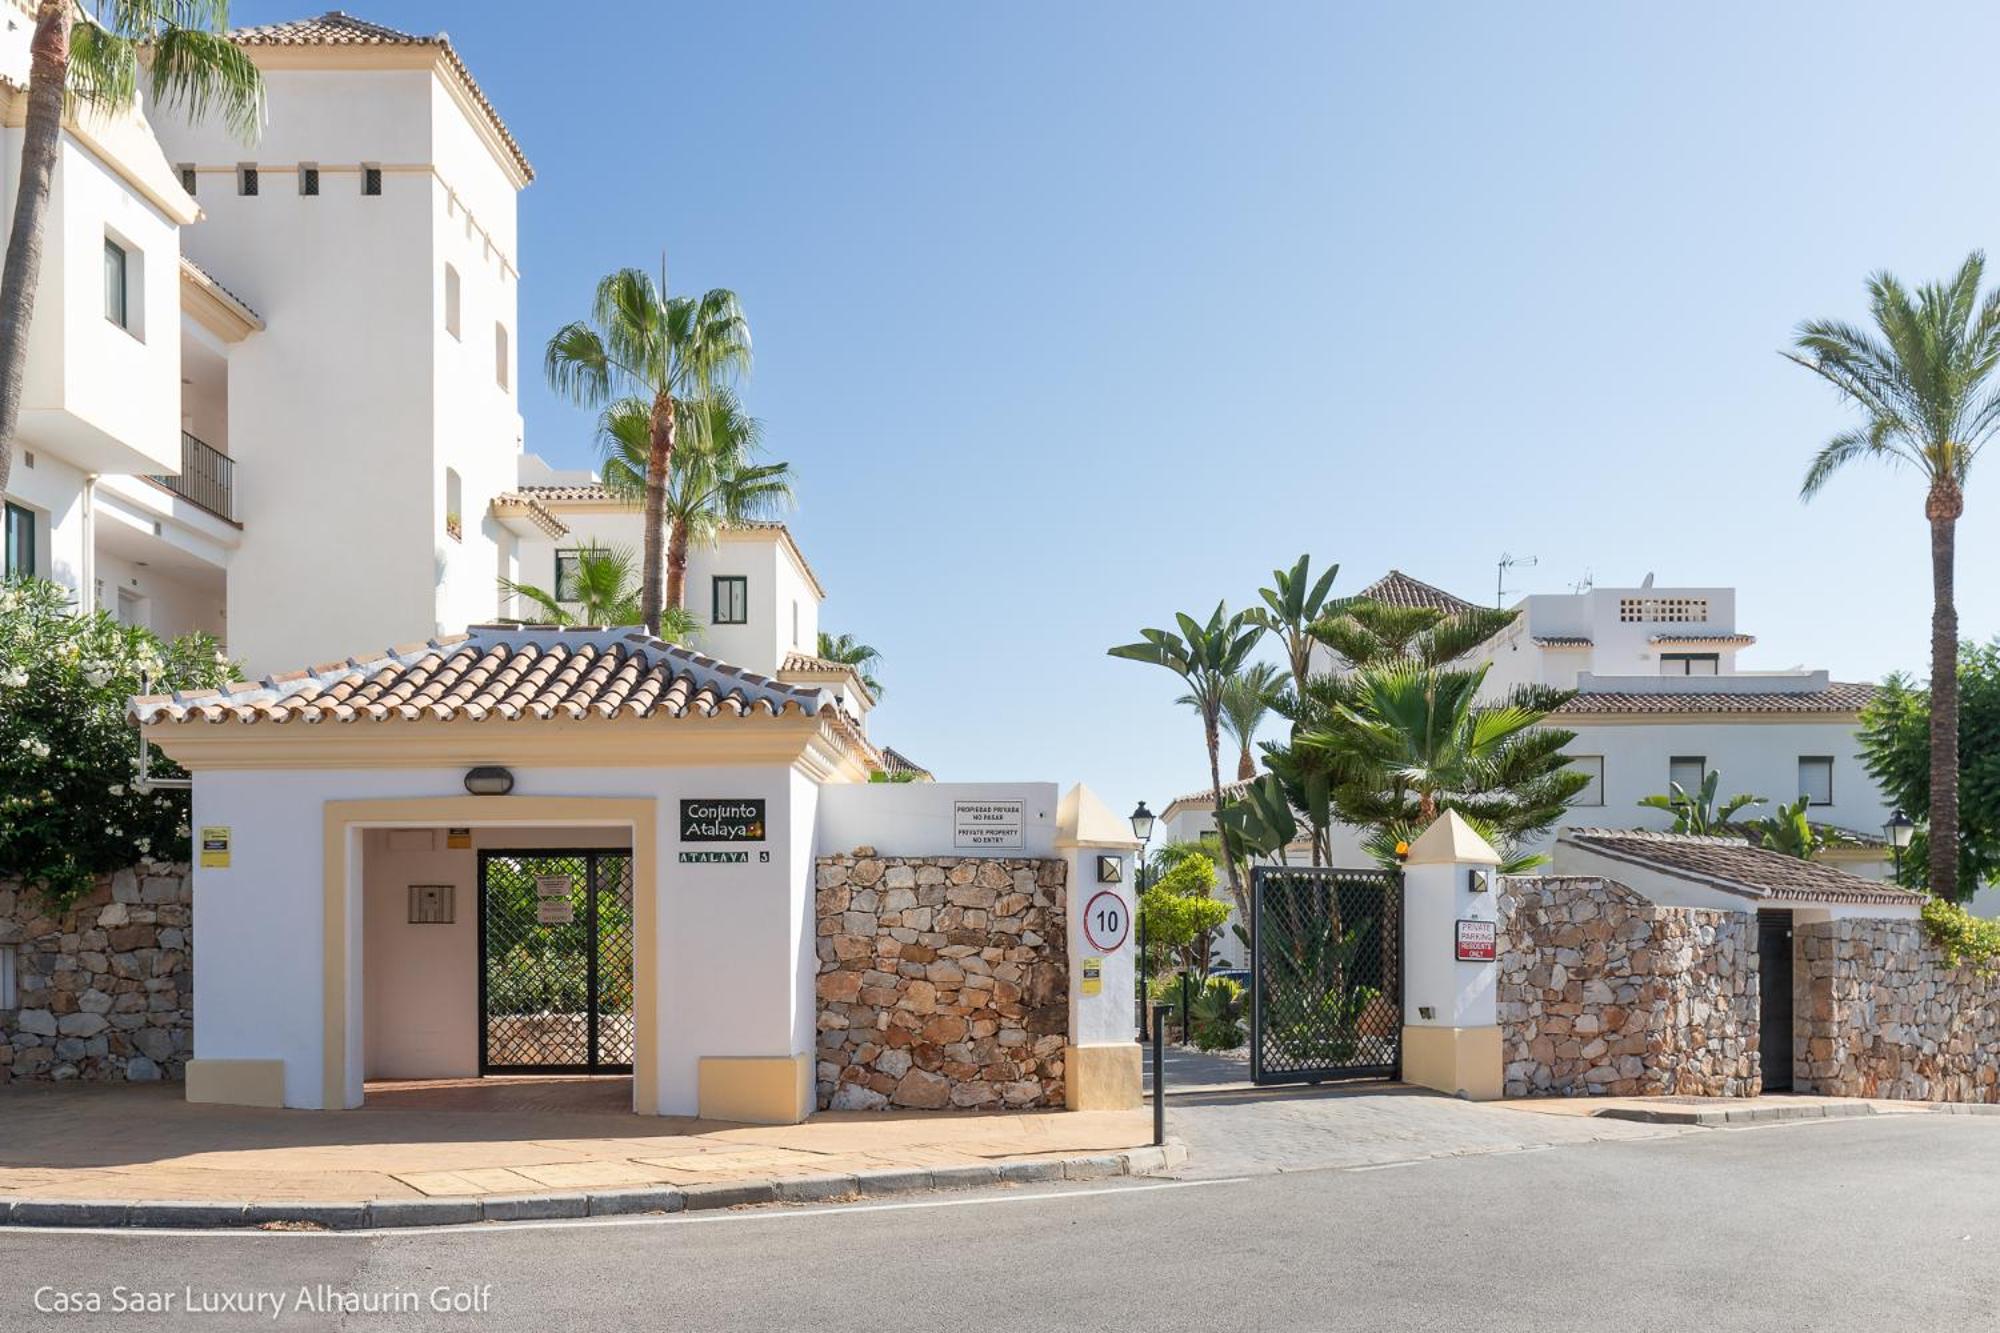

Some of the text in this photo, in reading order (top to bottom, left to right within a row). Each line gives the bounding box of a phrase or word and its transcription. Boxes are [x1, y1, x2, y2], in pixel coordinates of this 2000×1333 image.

[688, 804, 757, 821] Conjunto
[686, 820, 747, 840] Atalaya
[680, 852, 748, 862] ATALAYA
[1097, 910, 1119, 932] 10
[1462, 923, 1491, 931] PRIVATE
[1461, 932, 1493, 941] PARKING
